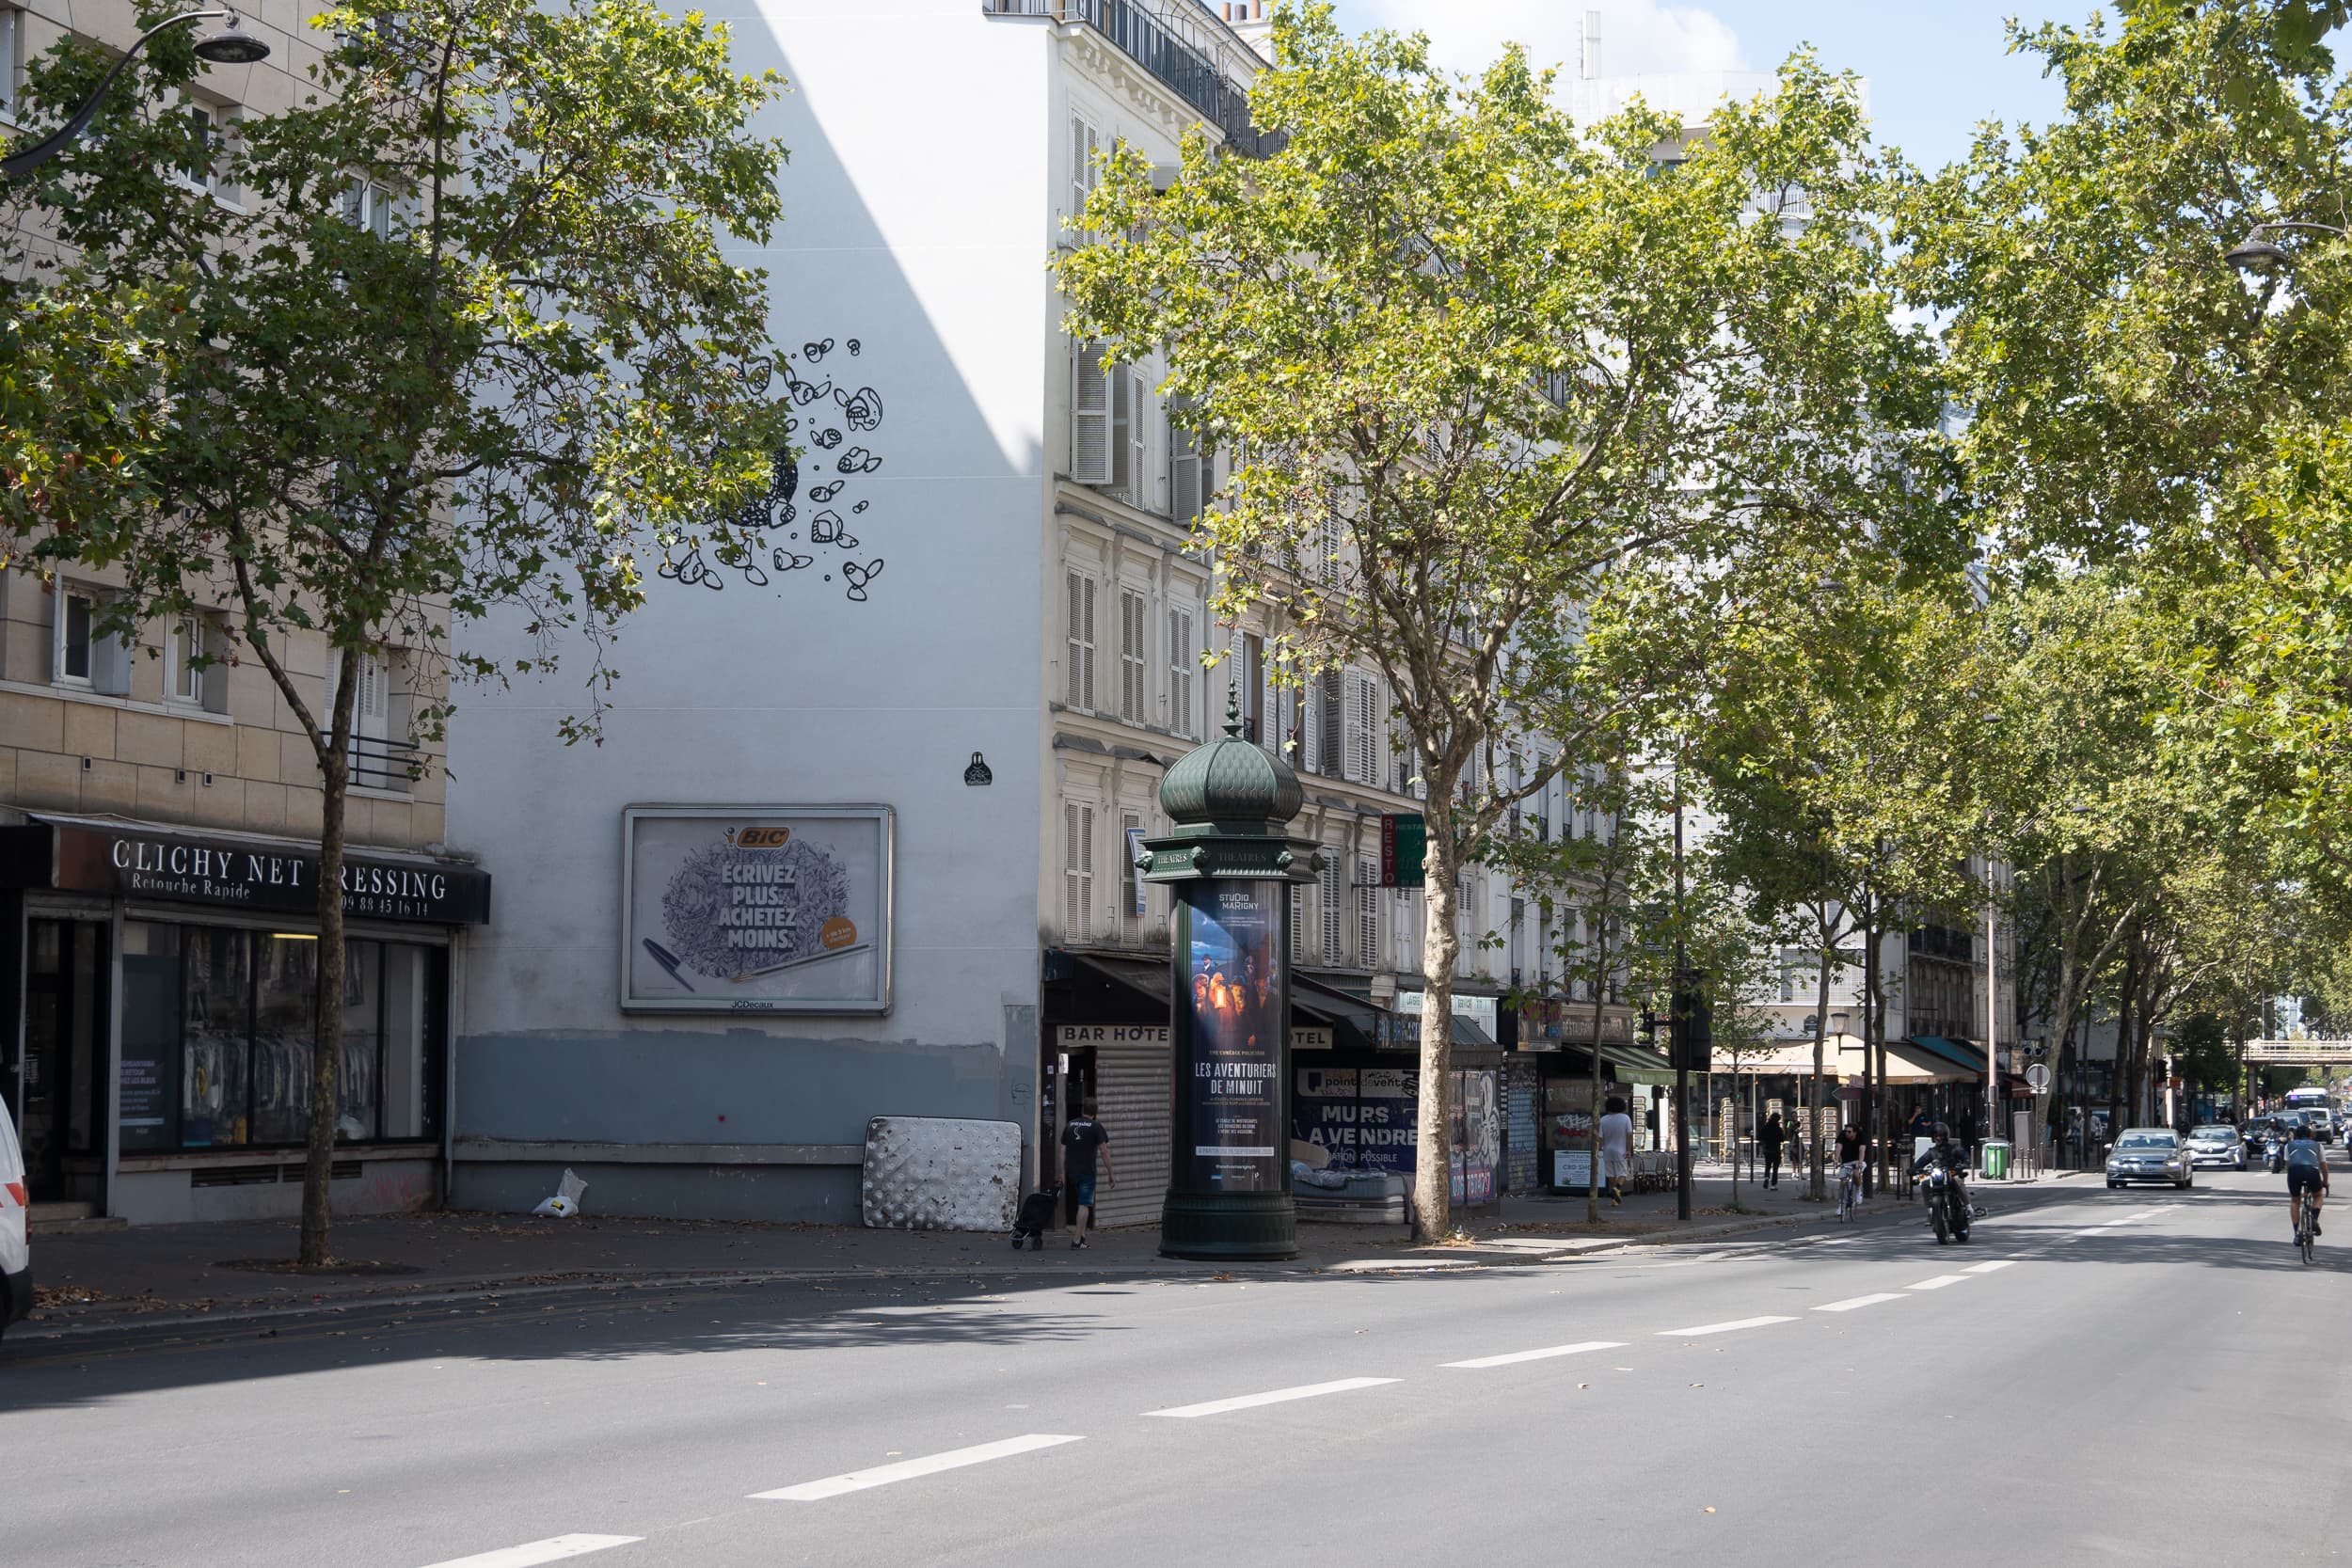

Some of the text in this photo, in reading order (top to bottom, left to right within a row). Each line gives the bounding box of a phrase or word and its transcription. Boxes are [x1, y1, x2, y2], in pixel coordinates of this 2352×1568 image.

[1384, 818, 1395, 884] RESTO
[113, 839, 446, 899] CLICHY NET RESSING
[132, 872, 251, 900] Retouche Rapide
[732, 886, 783, 905] PLUS.
[718, 908, 797, 927] ACHETEZ
[728, 929, 793, 948] MOINS.
[732, 1000, 773, 1009] JCDecaux
[1064, 1027, 1168, 1041] BAR HOTE
[1291, 1032, 1325, 1044] TEL
[1195, 1062, 1277, 1079] LES AVENTURIERS
[1211, 1080, 1263, 1095] DE MINUIT
[1322, 1105, 1389, 1123] MURS
[1327, 1128, 1418, 1146] VENDRE
[1360, 1153, 1398, 1163] POSSIBLE
